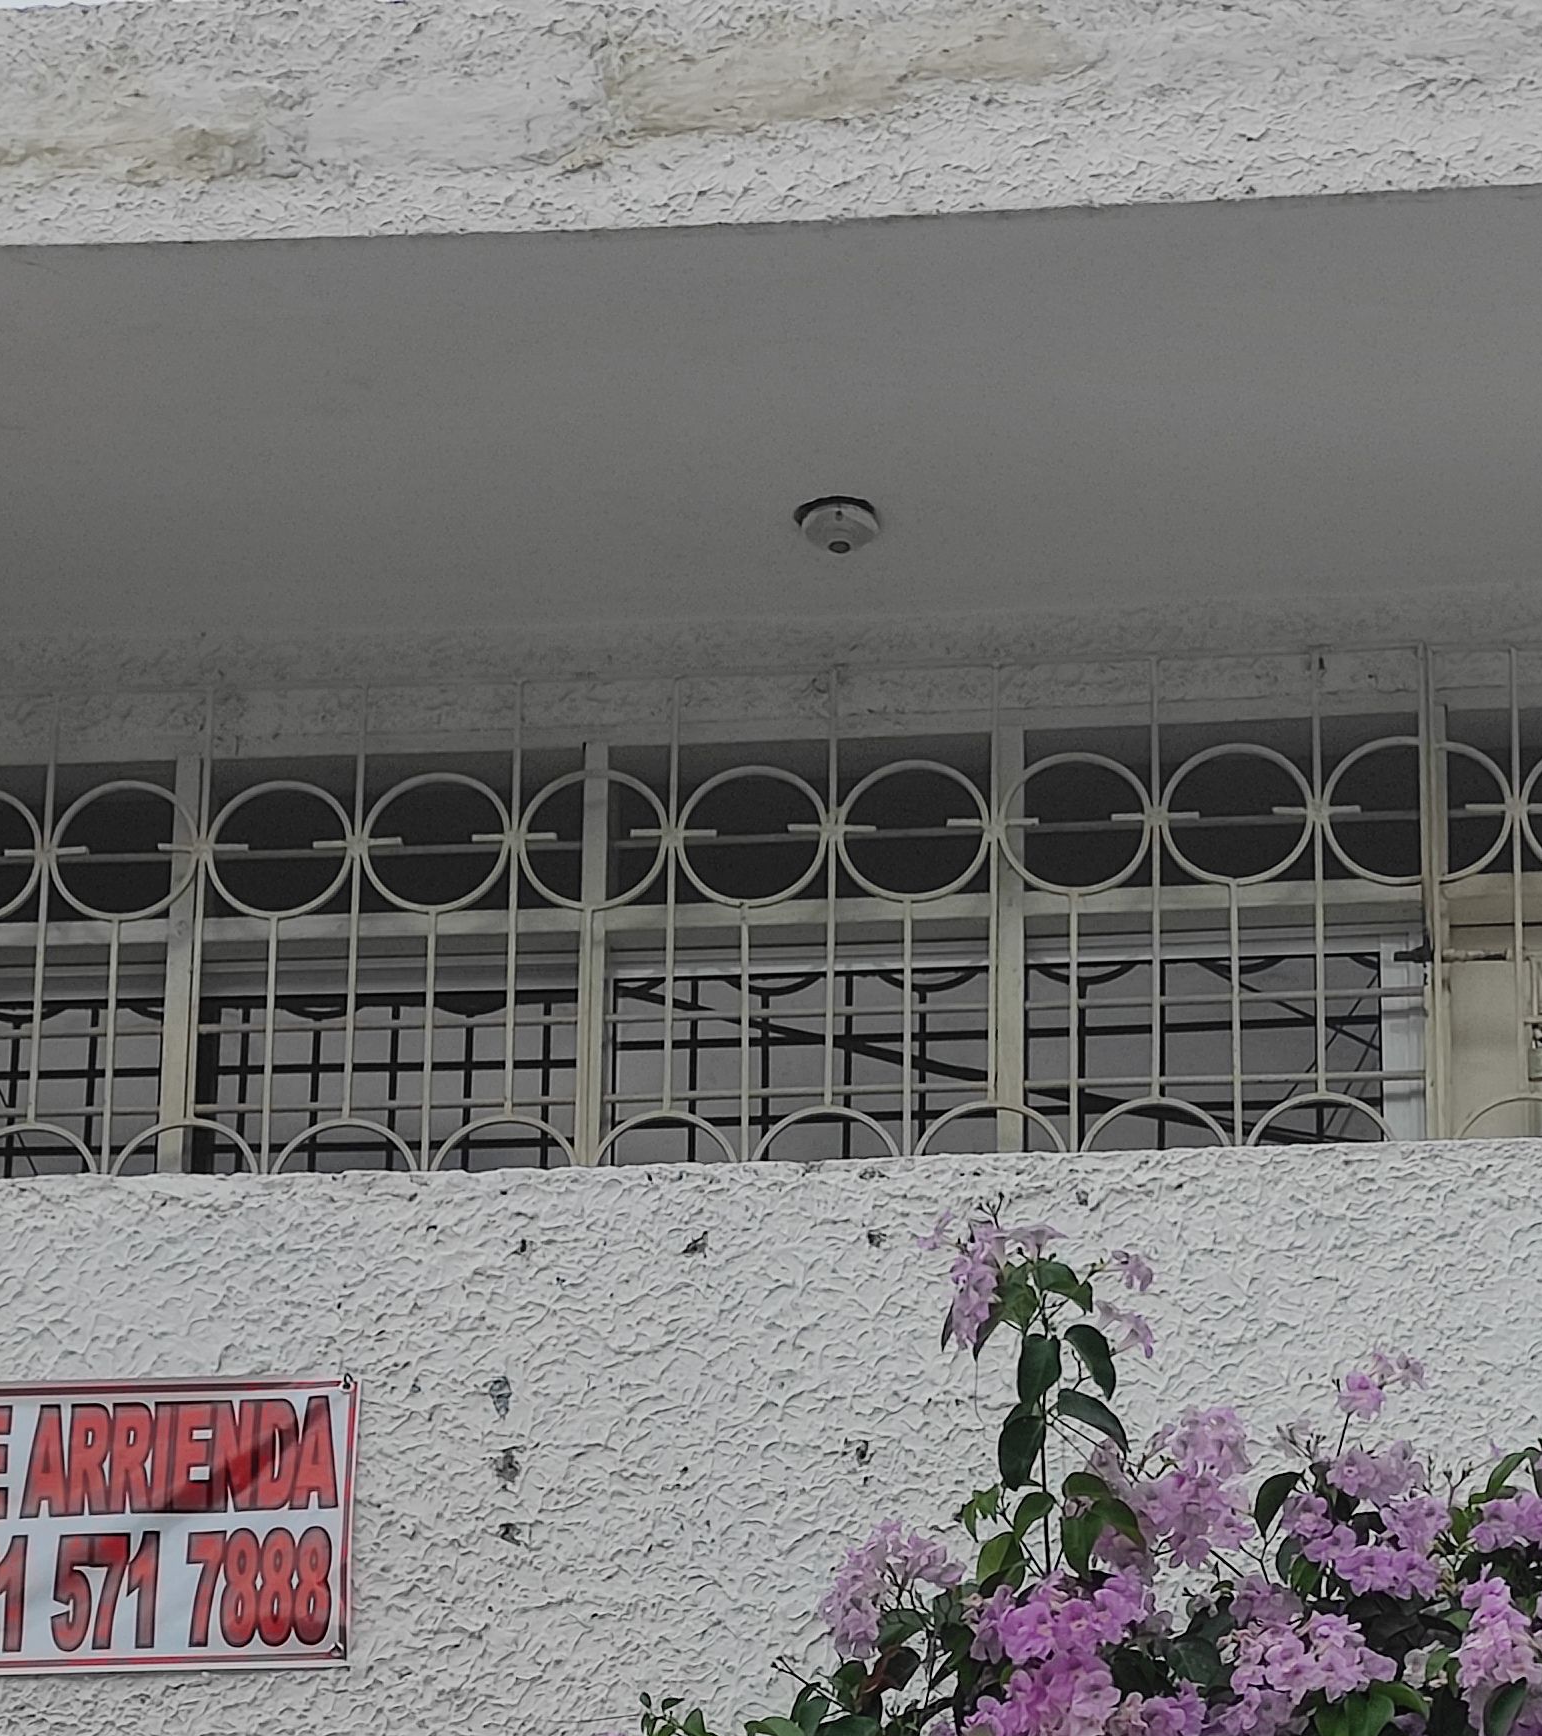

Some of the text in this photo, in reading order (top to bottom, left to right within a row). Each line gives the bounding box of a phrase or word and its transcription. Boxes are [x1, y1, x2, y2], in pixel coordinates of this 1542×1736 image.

[20, 1396, 339, 1519] ARRIENDA
[50, 1531, 160, 1653] 571
[186, 1526, 333, 1648] 7888
